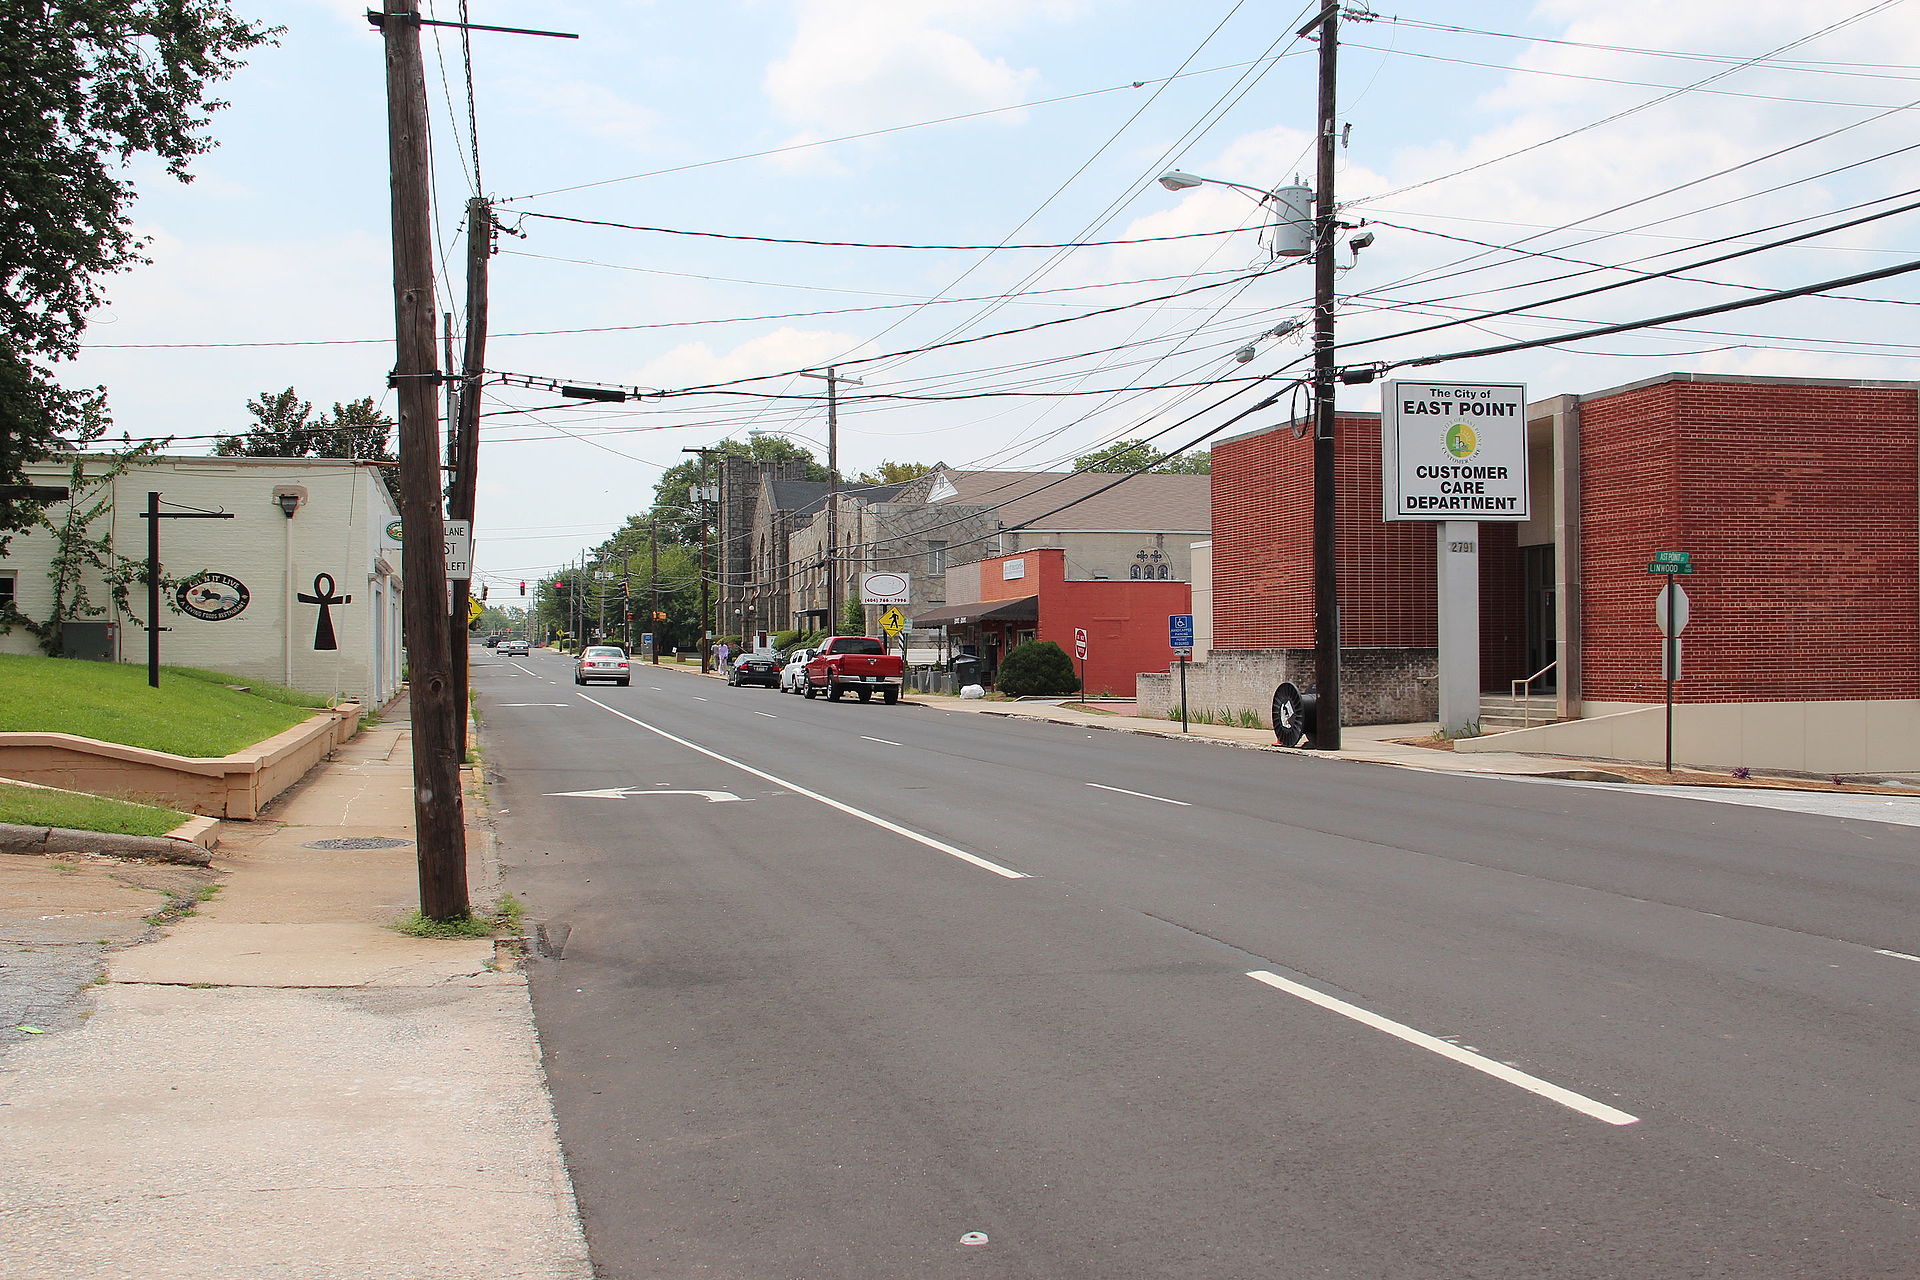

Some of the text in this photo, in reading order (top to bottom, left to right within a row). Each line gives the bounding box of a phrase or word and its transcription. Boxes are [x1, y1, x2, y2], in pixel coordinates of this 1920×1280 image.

[1430, 389, 1491, 400] The City of
[1403, 401, 1517, 417] EAST POINT
[1416, 465, 1508, 479] CUSTOMER
[1440, 481, 1485, 494] CARE
[1406, 496, 1518, 510] DEPARTMENT
[444, 527, 465, 537] LANE
[1451, 542, 1473, 553] 2791
[1668, 553, 1681, 561] POINT
[446, 561, 467, 571] LEFT
[1650, 564, 1678, 573] LINWOOD
[222, 576, 240, 589] LIVE
